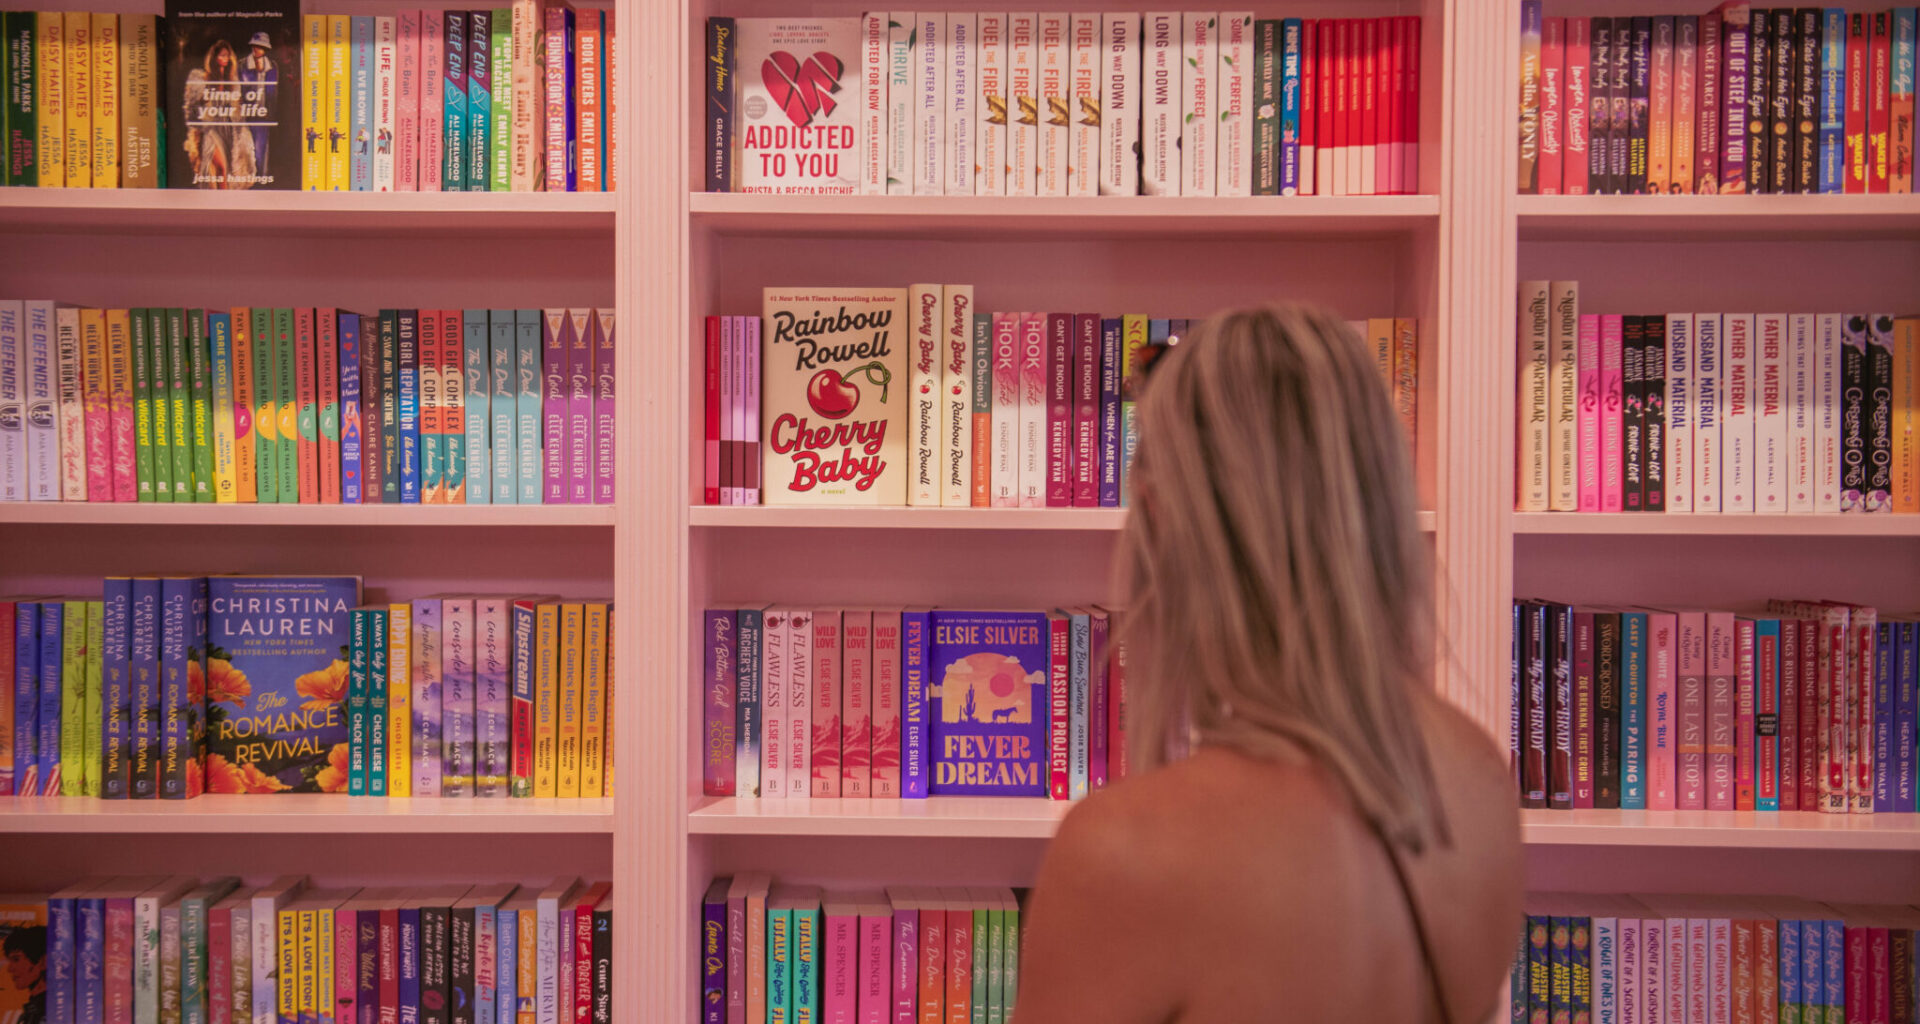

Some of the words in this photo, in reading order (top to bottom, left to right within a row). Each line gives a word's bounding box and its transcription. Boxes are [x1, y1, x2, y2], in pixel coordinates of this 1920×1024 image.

[472, 15, 486, 48] DEEP
[712, 25, 730, 64] Stealing
[869, 17, 880, 62] ADDICTED
[1016, 19, 1030, 49] FUEL
[1112, 21, 1125, 52] LONG
[1731, 33, 1745, 54] OUT
[103, 28, 112, 68] DAISY
[381, 48, 390, 72] LIFE,
[550, 36, 562, 70] FUNNY
[582, 37, 593, 61] BOOK
[894, 41, 908, 85] THRIVE
[1018, 52, 1026, 64] THE
[1114, 56, 1122, 72] WAY
[472, 51, 486, 78] END
[716, 67, 728, 91] Home
[869, 66, 879, 84] FOR
[1730, 58, 1745, 72] OF
[103, 71, 112, 116] HAITES
[203, 90, 240, 100] time
[246, 90, 263, 100] of
[550, 72, 562, 111] STORY
[582, 64, 593, 104] LOVERS
[869, 87, 879, 110] NOW
[1014, 69, 1028, 97] FIRE
[1112, 75, 1124, 110] DOWN
[1728, 76, 1745, 104] STEP,
[198, 106, 236, 118] your
[241, 105, 268, 116] life
[582, 112, 594, 142] EMILY
[1728, 109, 1744, 136] INTO
[550, 117, 562, 147] EMILY
[745, 126, 854, 149] ADDICTED
[128, 127, 138, 178] HASTINGS
[140, 136, 150, 167] JESSA
[550, 149, 562, 182] HENRY
[582, 145, 594, 182] HENRY
[760, 154, 788, 177] TO
[796, 154, 838, 177] YOU
[1728, 140, 1743, 162] YOU
[193, 174, 223, 184] jessa
[228, 174, 274, 184] hastings
[32, 309, 46, 338] THE
[400, 318, 412, 337] BAD
[773, 307, 892, 342] Rainbow
[920, 293, 936, 336] Cherry
[1529, 297, 1547, 338] NOBODY
[60, 326, 72, 361] HELENA
[423, 318, 434, 346] GOOD
[977, 321, 987, 344] Isn't
[1000, 321, 1012, 369] HOOK
[1056, 320, 1064, 345] CAN'T
[1534, 340, 1546, 350] IN
[1672, 320, 1686, 372] HUSBAND
[1731, 320, 1746, 359] FATHER
[400, 342, 412, 366] GIRL
[424, 351, 435, 376] GIRL
[796, 332, 891, 370] Rowell
[918, 340, 934, 374] Baby
[978, 348, 987, 357] It
[1056, 348, 1064, 362] GET
[33, 341, 48, 398] DEFENDER
[61, 364, 73, 402] HUNTING
[977, 360, 987, 408] Obvious?
[1056, 366, 1064, 400] ENOUGH
[400, 369, 414, 430] REPUTATION
[1530, 353, 1546, 422] PARTICULAR
[1672, 378, 1686, 429] MATERIAL
[1731, 365, 1746, 416] MATERIAL
[424, 380, 436, 430] COMPLEX
[138, 400, 150, 446] Wildcard
[770, 413, 888, 454] Cherry
[920, 400, 932, 446] Rainbow
[788, 448, 886, 492] Baby
[920, 448, 932, 484] Rowell
[212, 598, 348, 613] CHRISTINA
[106, 601, 114, 654] LAUREN
[115, 595, 124, 661] CHRISTINA
[225, 619, 334, 635] LAUREN
[816, 626, 836, 637] WILD
[936, 626, 979, 644] ELSIE
[985, 627, 1039, 644] SILVER
[515, 613, 531, 695] Slipstream
[816, 639, 835, 649] LOVE
[909, 622, 921, 665] FEVER
[768, 634, 780, 707] FLAWLESS
[821, 659, 831, 679] ELSIE
[1579, 676, 1588, 689] ZOE
[257, 692, 289, 712] The
[821, 681, 830, 708] SILVER
[908, 670, 920, 722] DREAM
[1053, 665, 1067, 717] PASSION
[1685, 678, 1699, 706] ONE
[110, 684, 119, 732] ROMANCE
[220, 706, 339, 740] ROMANCE
[1579, 692, 1588, 730] BRENNAN,
[353, 713, 362, 744] CHLOE
[910, 727, 918, 747] ELSIE
[1579, 733, 1588, 754] FIRST
[1685, 713, 1699, 746] LAST
[1878, 723, 1886, 759] HEATED
[108, 736, 119, 773] REVIVAL
[236, 736, 324, 764] REVIVAL
[352, 747, 361, 770] LIESE
[909, 749, 918, 776] SILVER
[945, 735, 1030, 758] FEVER
[1053, 722, 1066, 773] PROJECT
[936, 762, 1038, 785] DREAM
[1579, 757, 1588, 781] CRUSH
[1685, 753, 1699, 787] STOP
[1878, 762, 1886, 800] RIVALRY
[284, 916, 292, 936] IT'S
[578, 915, 592, 940] FIRST
[774, 917, 786, 962] TOTALLY
[284, 949, 292, 974] LOVE
[284, 978, 292, 1010] STORY
[578, 960, 590, 1000] FOREVER
[1532, 962, 1540, 994] AFFAIR
[1540, 966, 1548, 1002] AUSTEN
